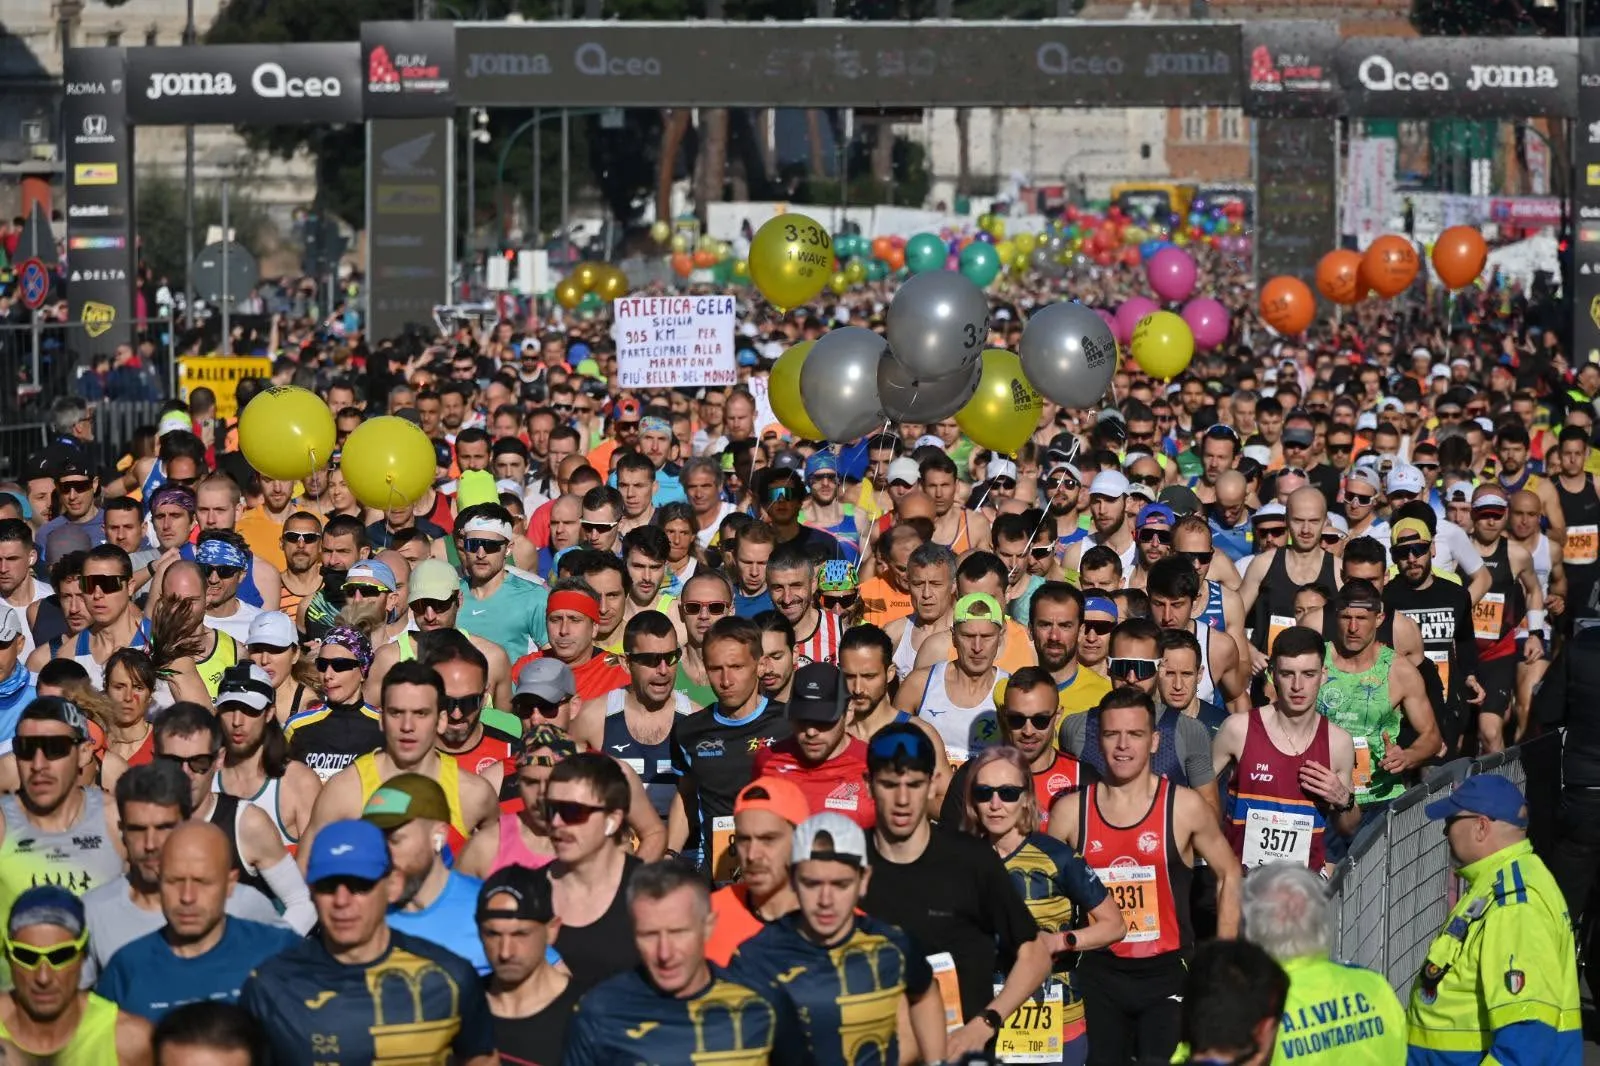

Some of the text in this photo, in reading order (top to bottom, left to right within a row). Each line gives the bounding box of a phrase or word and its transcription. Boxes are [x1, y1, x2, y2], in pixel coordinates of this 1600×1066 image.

[395, 54, 427, 68] RUN
[66, 82, 106, 95] ROMA
[784, 223, 830, 250] 3:30
[797, 251, 828, 268] WAVE
[83, 269, 126, 281] DELTA
[652, 317, 693, 328] SICILIA
[625, 327, 717, 344] 905 KM PER
[620, 343, 722, 359] PARTECIPARE ALLA
[649, 357, 713, 369] MARATONA
[683, 370, 698, 382] DEL
[703, 369, 735, 382] MONDO
[1427, 611, 1455, 623] TILL
[1256, 763, 1269, 771] PM
[1260, 826, 1298, 853] 3577
[1264, 850, 1284, 858] PATRICK
[1128, 920, 1139, 932] A
[1281, 1015, 1385, 1059] VOLONTARIATO
[1002, 1040, 1044, 1052] F4 TOP
